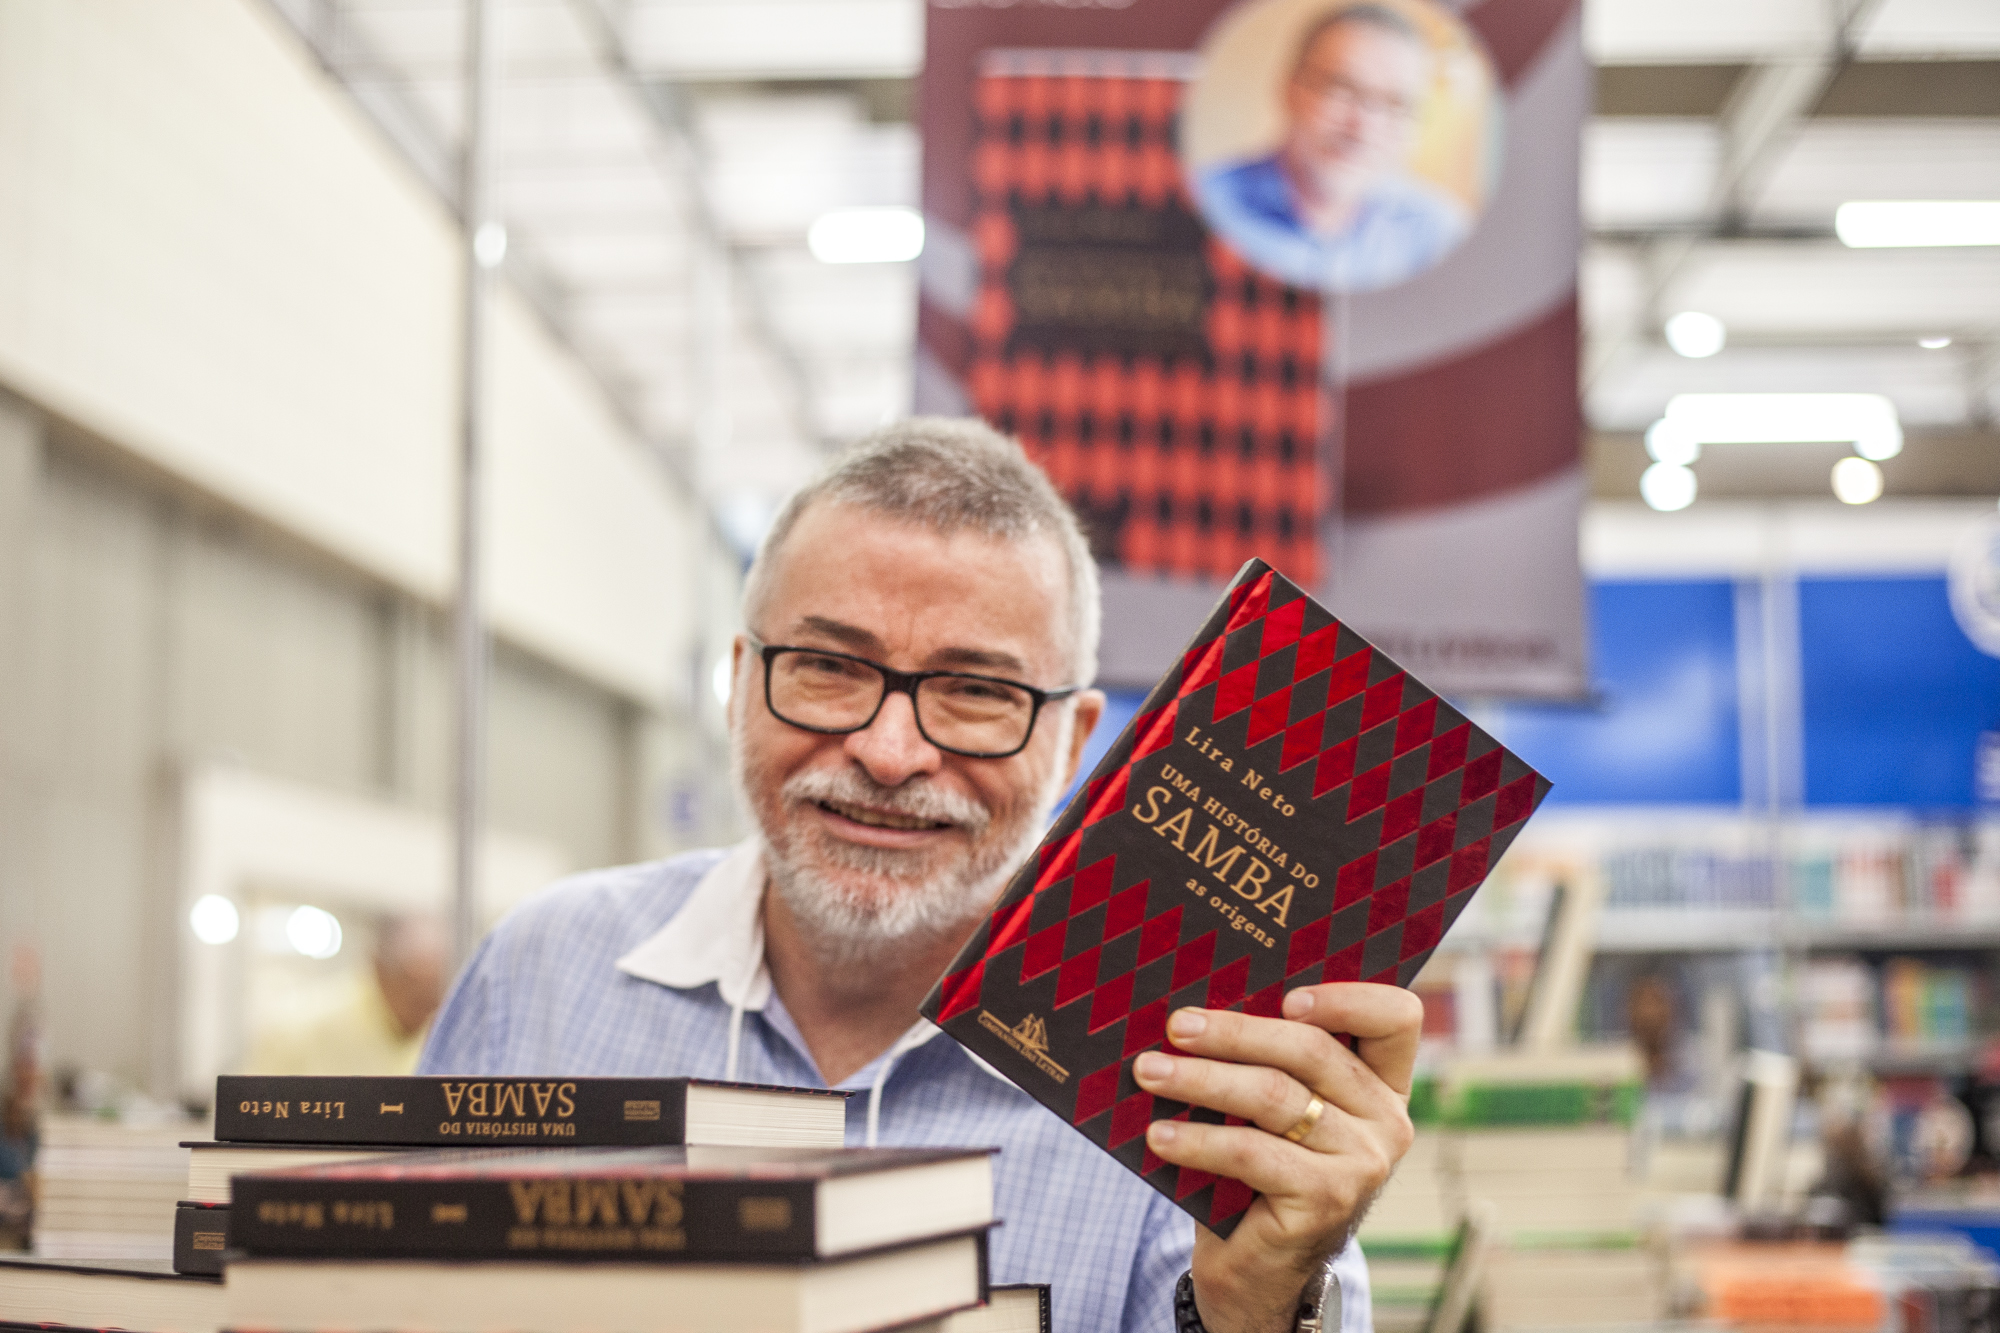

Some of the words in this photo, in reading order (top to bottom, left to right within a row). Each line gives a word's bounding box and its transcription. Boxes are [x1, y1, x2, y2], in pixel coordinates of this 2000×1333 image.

[1184, 726, 1234, 773] Lira
[1240, 768, 1297, 818] Neto
[1160, 763, 1202, 803] UMA
[1201, 796, 1289, 869] HISTÓRIA
[1289, 862, 1321, 890] DO
[1131, 785, 1297, 929] SAMBA
[1185, 878, 1209, 898] as
[1209, 896, 1277, 950] origens
[239, 1100, 291, 1120] Neto
[299, 1101, 347, 1120] Lira
[441, 1082, 578, 1118] SAMBA
[439, 1121, 462, 1136] DO
[465, 1121, 539, 1139] HISTÓRIA
[542, 1121, 578, 1136] UMA
[508, 1178, 686, 1227] SAMBA
